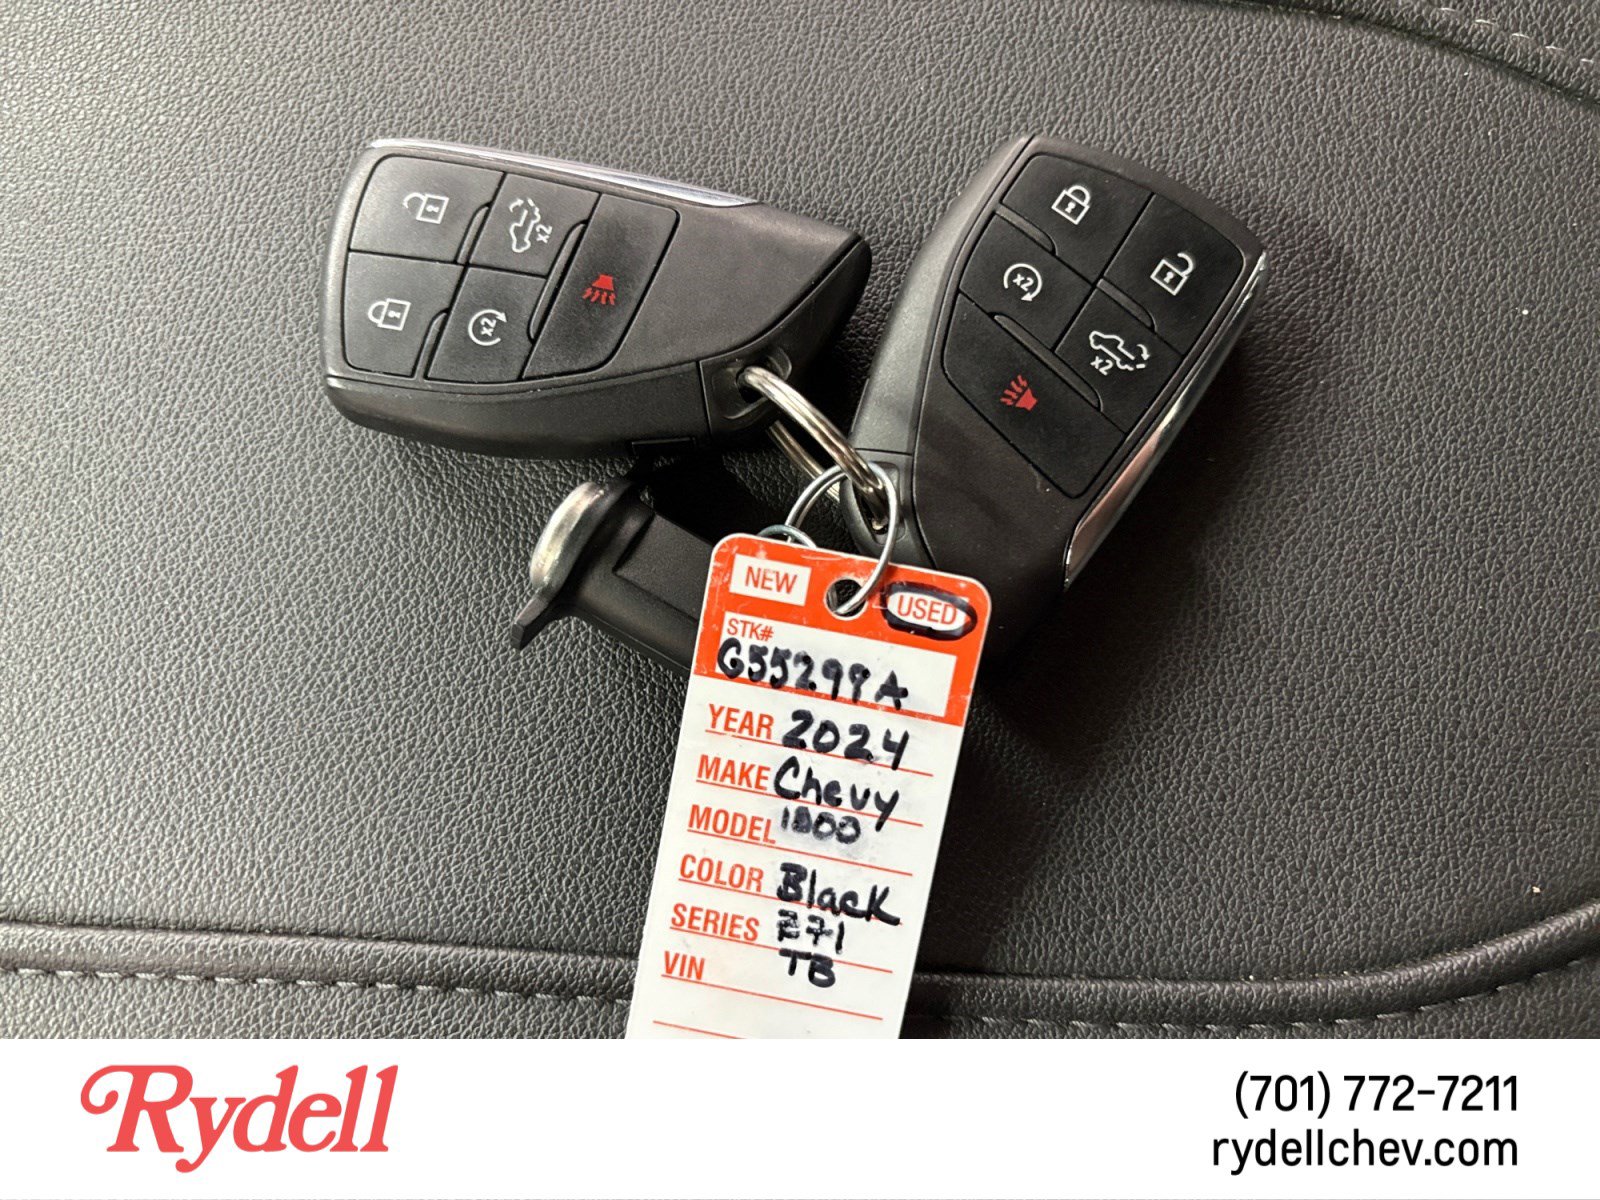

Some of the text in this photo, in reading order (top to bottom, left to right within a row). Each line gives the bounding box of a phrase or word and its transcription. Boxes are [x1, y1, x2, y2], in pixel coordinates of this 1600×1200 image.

[1013, 272, 1034, 291] x2
[481, 316, 498, 336] x2
[1090, 356, 1113, 375] x2
[745, 566, 797, 594] NEW
[897, 594, 957, 625] USED
[727, 619, 774, 642] STK#
[708, 704, 774, 740] YEAR
[782, 709, 909, 770] 2024
[697, 754, 771, 791] MAKE
[774, 756, 899, 832] Chevy
[688, 804, 776, 844] MODEL
[680, 854, 764, 892] COLOR
[671, 903, 760, 941] SERIES
[664, 951, 705, 980] VIN
